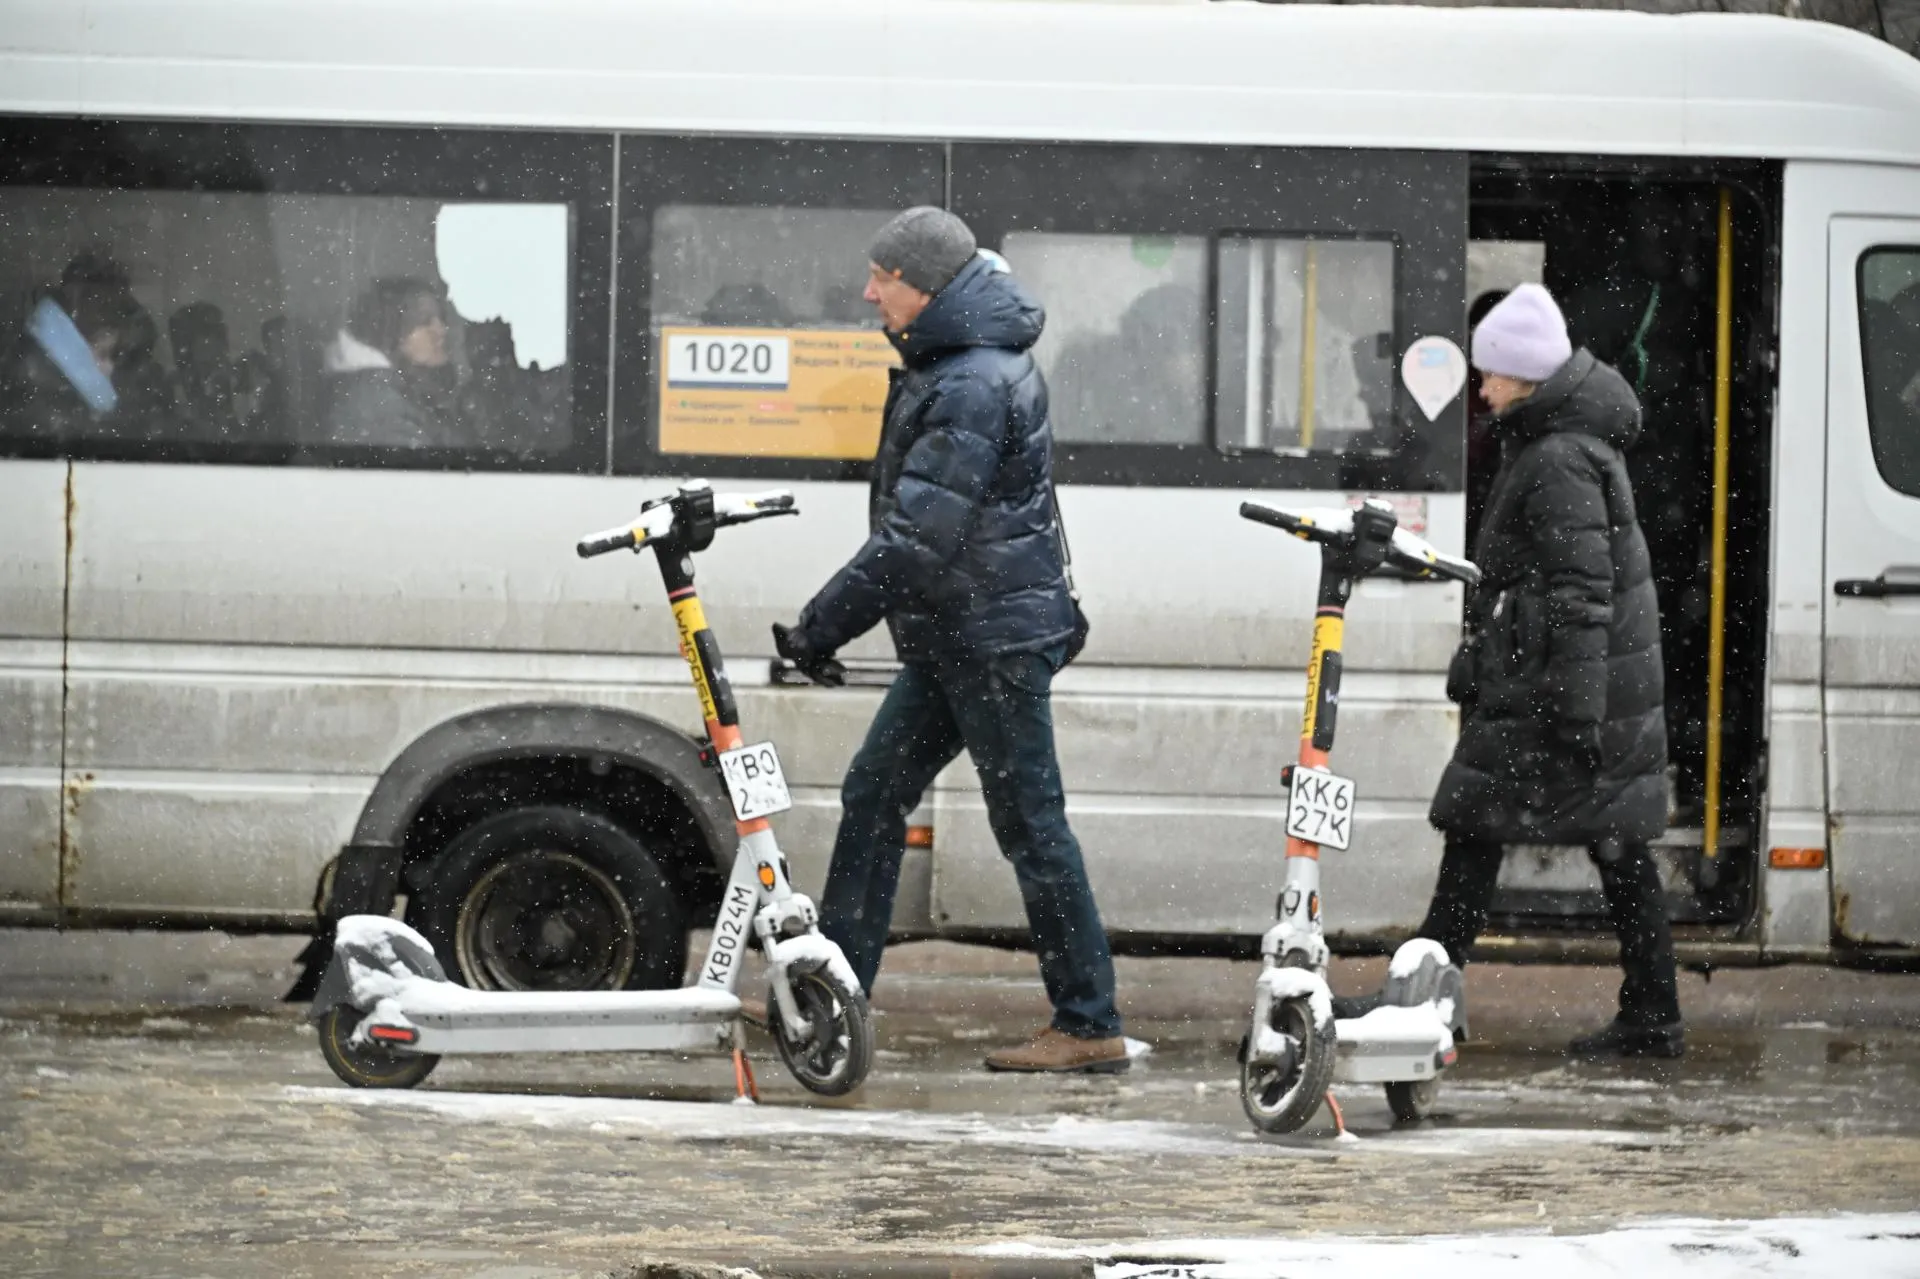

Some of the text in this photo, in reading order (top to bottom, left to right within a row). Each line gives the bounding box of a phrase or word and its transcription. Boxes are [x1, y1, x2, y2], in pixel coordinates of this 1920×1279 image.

[685, 341, 772, 374] 1020
[1295, 774, 1348, 811] KK6
[1292, 804, 1346, 843] 27K
